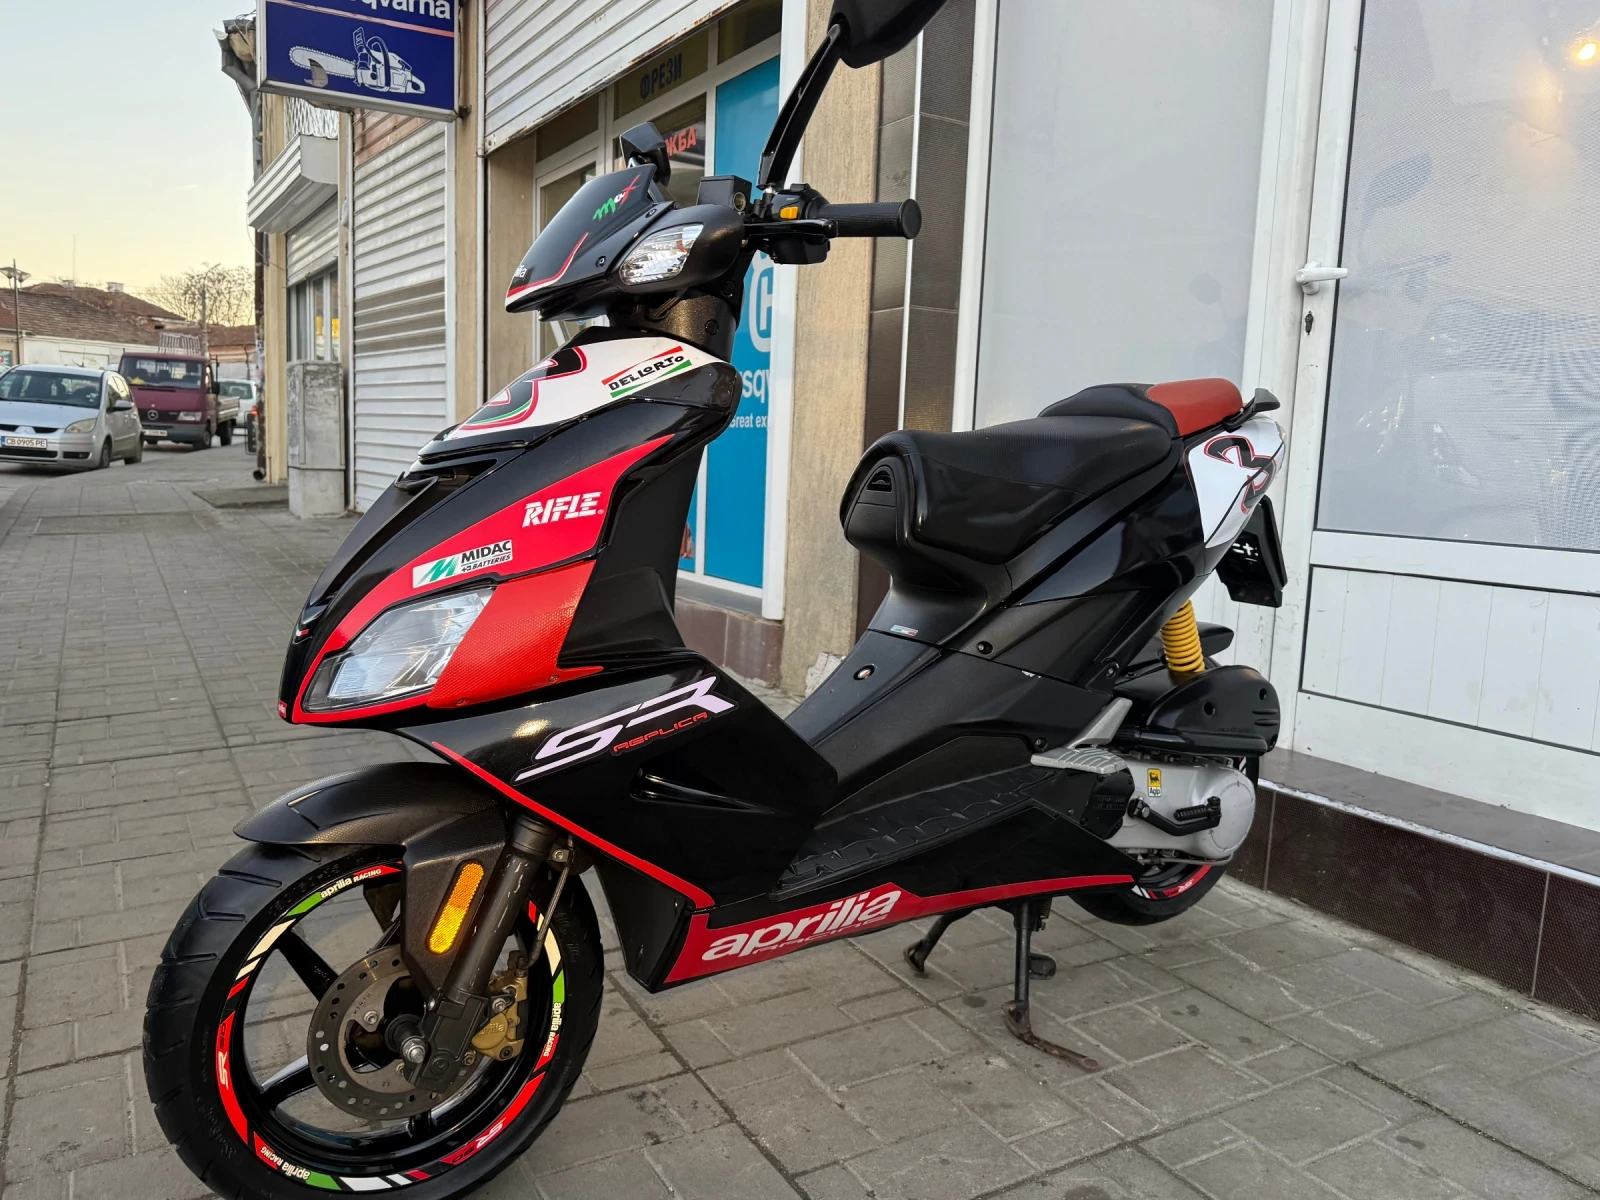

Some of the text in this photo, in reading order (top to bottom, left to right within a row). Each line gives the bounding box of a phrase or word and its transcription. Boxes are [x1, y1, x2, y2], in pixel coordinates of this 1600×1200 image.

[640, 53, 682, 100] ФРЕЗИ
[665, 126, 697, 157] ЖБА
[522, 492, 602, 528] RIFLE
[461, 540, 512, 564] MIDAC
[471, 553, 511, 571] BATTERIES
[515, 676, 735, 782] SR
[613, 711, 708, 752] REPLICA
[320, 868, 382, 899] aprilia RACING
[701, 890, 902, 958] aprilia
[543, 1002, 563, 1057] aprilia RACING
[260, 1146, 311, 1180] aprilia RACING
